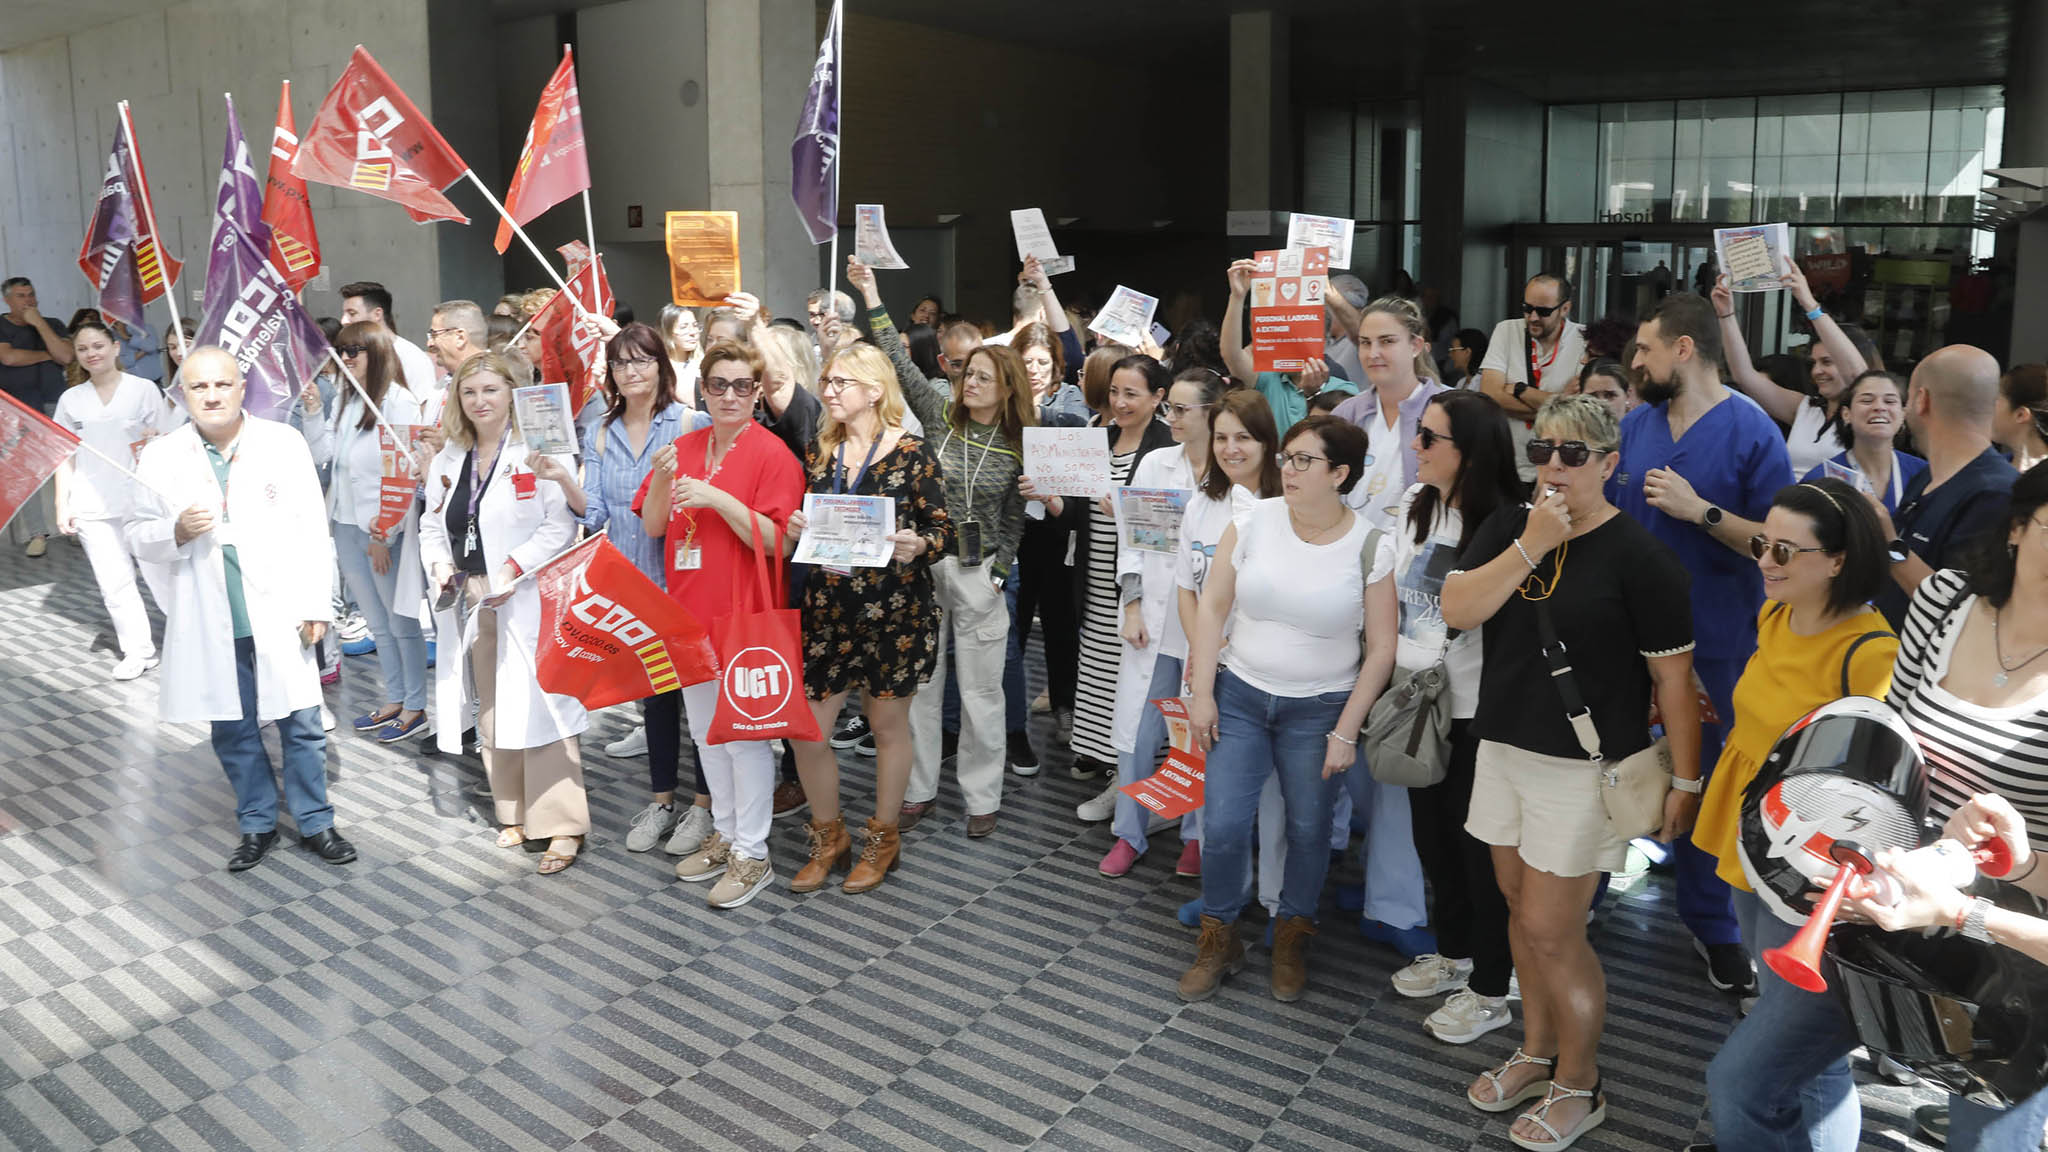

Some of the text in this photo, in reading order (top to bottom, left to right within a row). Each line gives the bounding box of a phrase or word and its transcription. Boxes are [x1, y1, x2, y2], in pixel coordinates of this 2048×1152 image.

[1036, 463, 1096, 473] NO SOMOS
[1049, 486, 1097, 496] TERCERA
[734, 665, 782, 699] UGT
